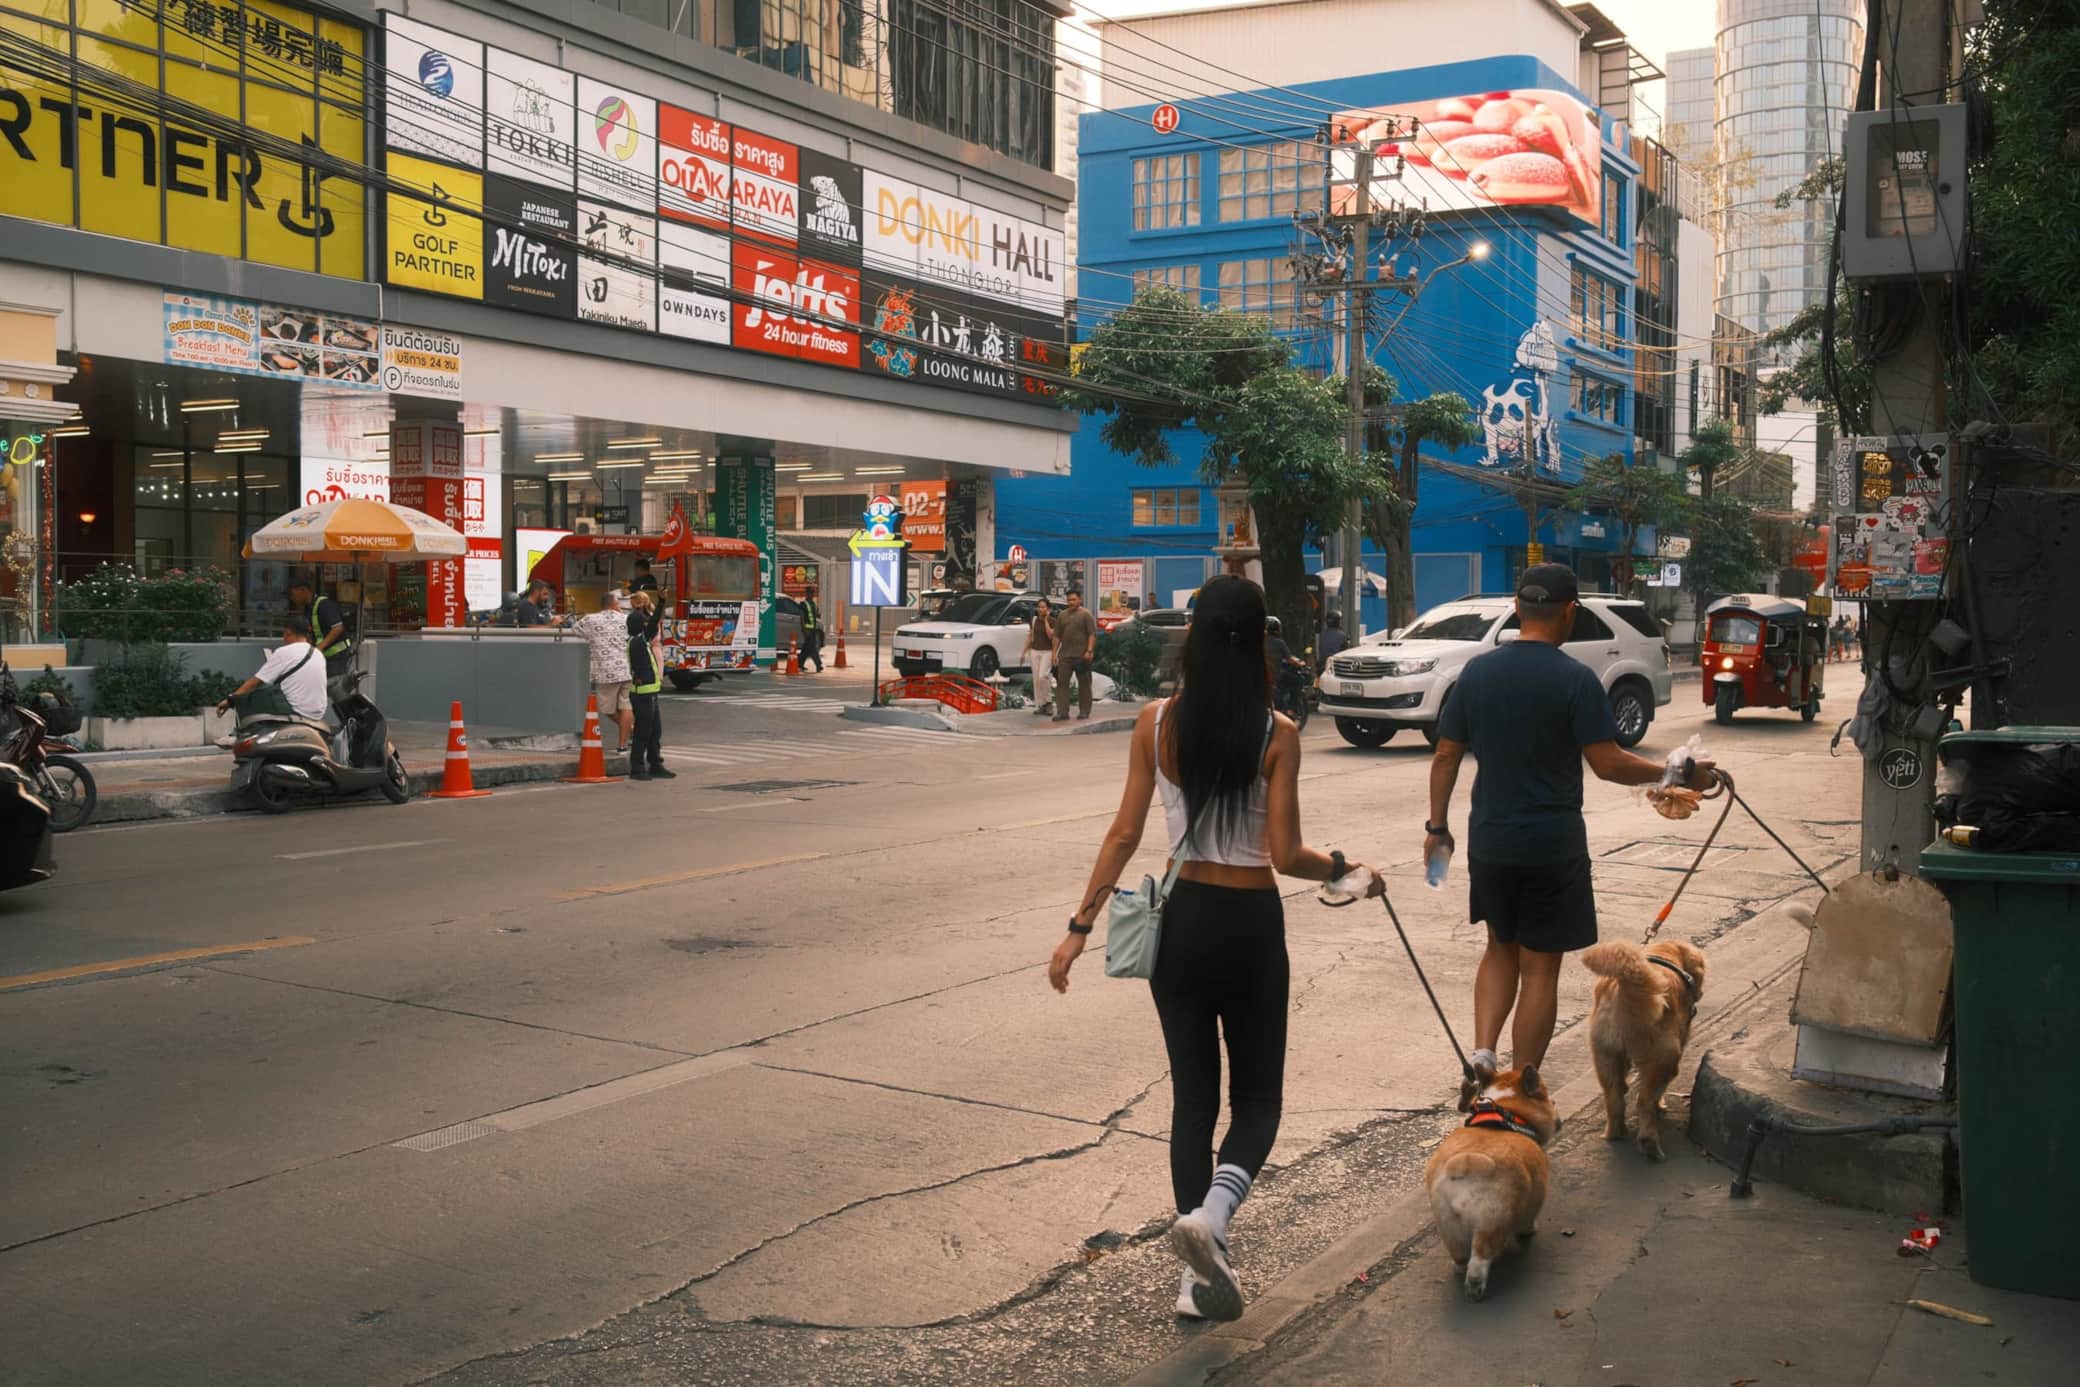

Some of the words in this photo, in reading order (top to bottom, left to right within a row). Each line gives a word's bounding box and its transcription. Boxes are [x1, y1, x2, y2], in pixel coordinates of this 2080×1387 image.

[690, 122, 730, 152] รับซื้อ
[735, 142, 784, 175] ราคาสูง
[662, 158, 796, 219] OTAKARAYA
[521, 201, 560, 217] JAPANESE
[521, 211, 569, 229] RESTAURANT
[806, 213, 858, 241] NAGIYA
[878, 187, 981, 262] DONKI
[992, 223, 1054, 282] HALL
[413, 234, 459, 255] GOLF
[580, 308, 618, 323] Yakiniku
[620, 315, 647, 329] Maeda
[663, 299, 727, 322] OWNDAYS
[385, 329, 460, 355] ยินดีต้อนรับ
[764, 324, 780, 342] 24
[782, 326, 809, 347] hour
[810, 333, 849, 354] fitness
[430, 357, 441, 368] 24
[923, 358, 969, 382] LOONG
[973, 369, 1005, 389] MALA
[340, 534, 377, 547] DONKI
[766, 525, 775, 551] BUS
[852, 561, 899, 605] IN
